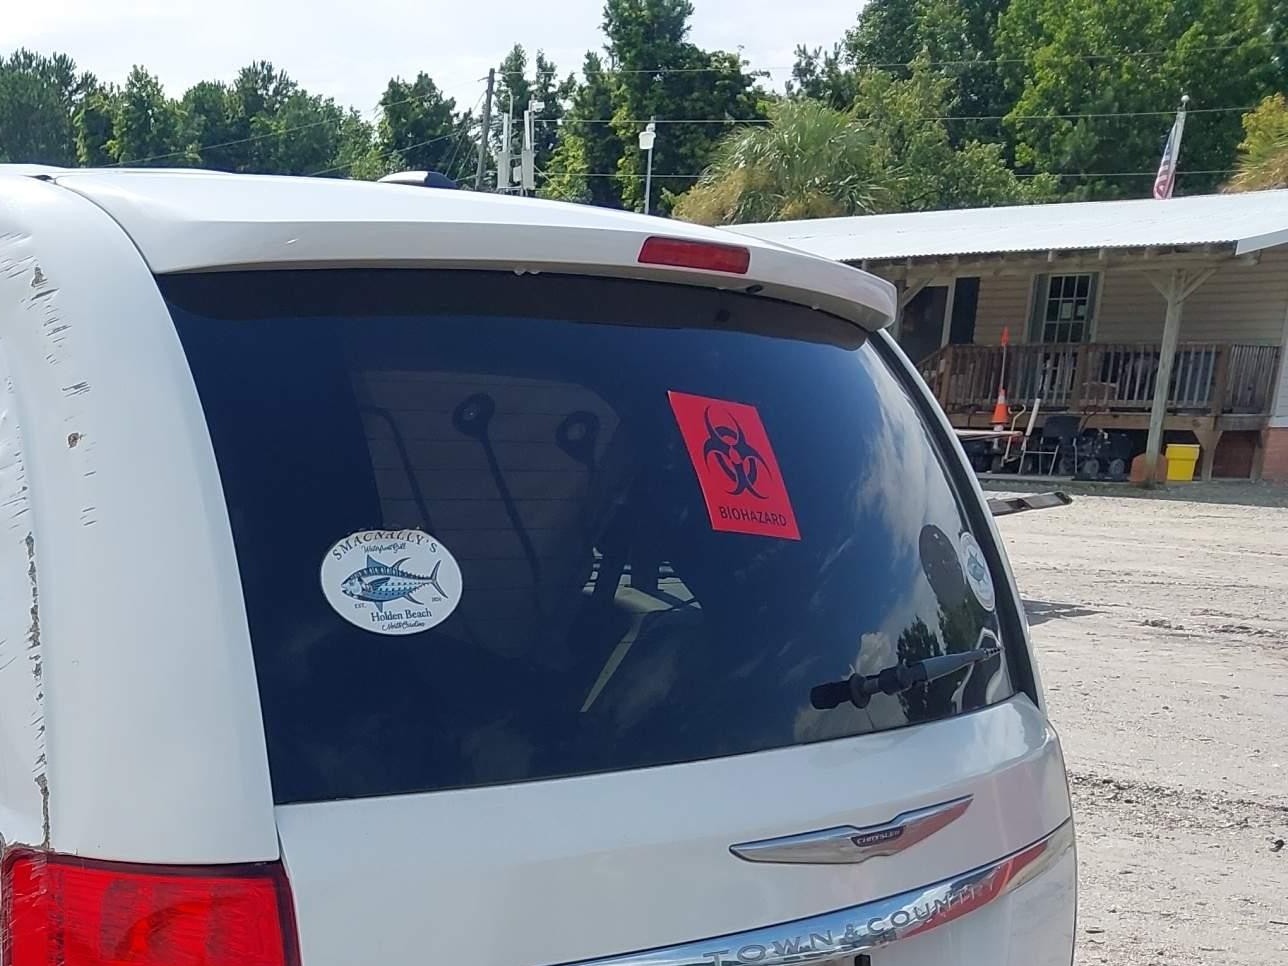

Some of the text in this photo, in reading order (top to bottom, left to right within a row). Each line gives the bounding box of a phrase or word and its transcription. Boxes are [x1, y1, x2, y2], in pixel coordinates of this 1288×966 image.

[719, 505, 787, 527] BIOHAZARD
[332, 530, 438, 561] SMACNALLY'S
[371, 607, 433, 622] Holden Beach
